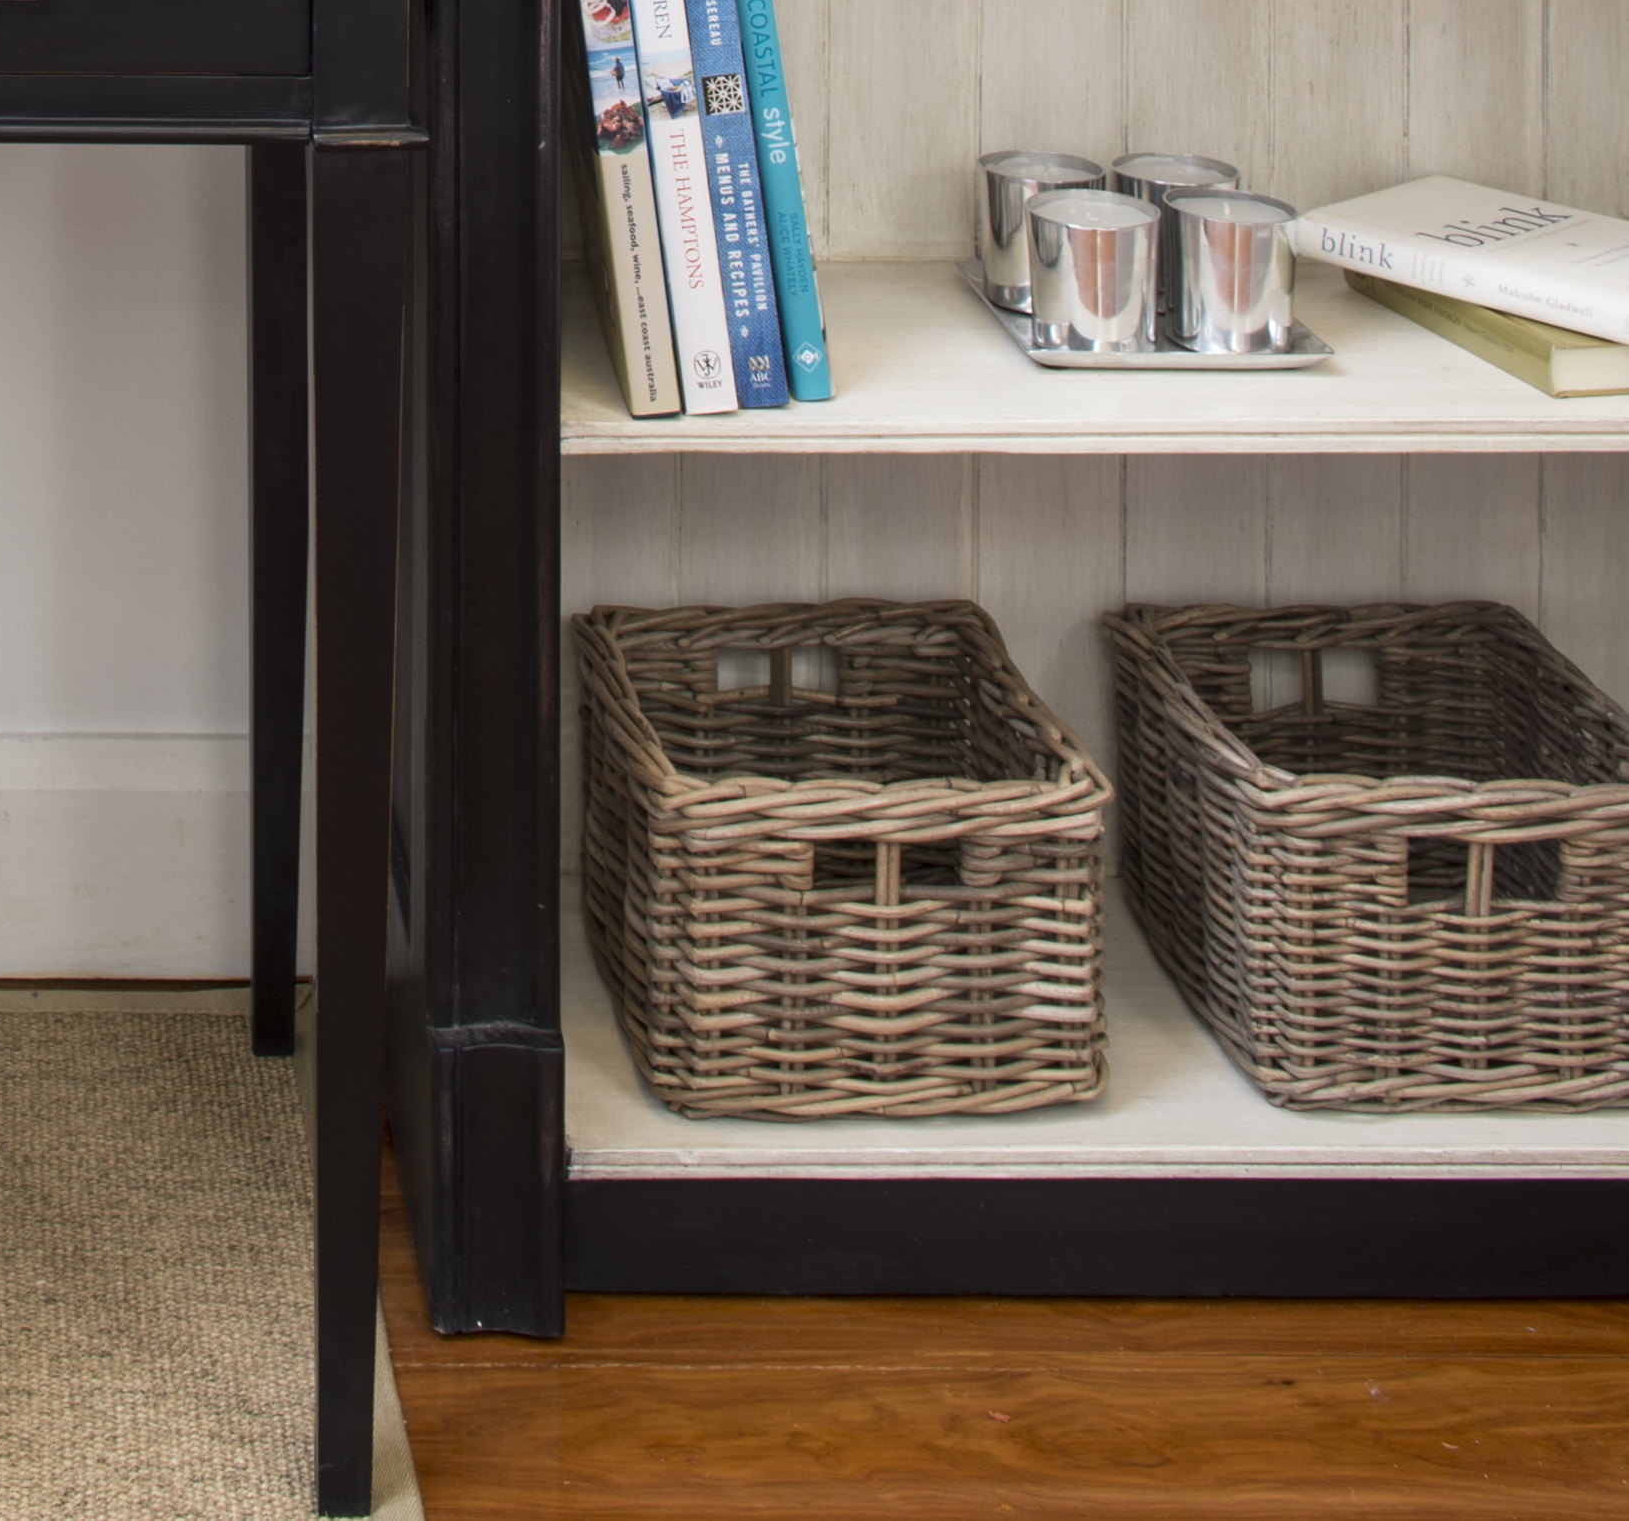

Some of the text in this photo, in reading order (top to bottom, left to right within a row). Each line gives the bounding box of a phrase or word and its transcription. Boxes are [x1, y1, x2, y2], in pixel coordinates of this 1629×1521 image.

[760, 108, 787, 165] style
[621, 164, 633, 201] sailing,
[627, 204, 638, 251] seafood,
[670, 129, 705, 290] THE HAMPTONS
[1415, 207, 1574, 248] blink
[715, 153, 750, 318] MENUS AND RECIPES
[737, 162, 768, 311] THE BATHERS' PAVILION
[778, 211, 799, 297] ALICE WHATELY
[790, 212, 809, 293] SALLY HAYDEN
[1321, 227, 1395, 271] blink
[632, 253, 641, 284] wine,
[1497, 284, 1594, 318] Malcolm Gladwell
[641, 321, 651, 352] coast
[645, 353, 658, 403] australia
[696, 380, 723, 389] WILEY
